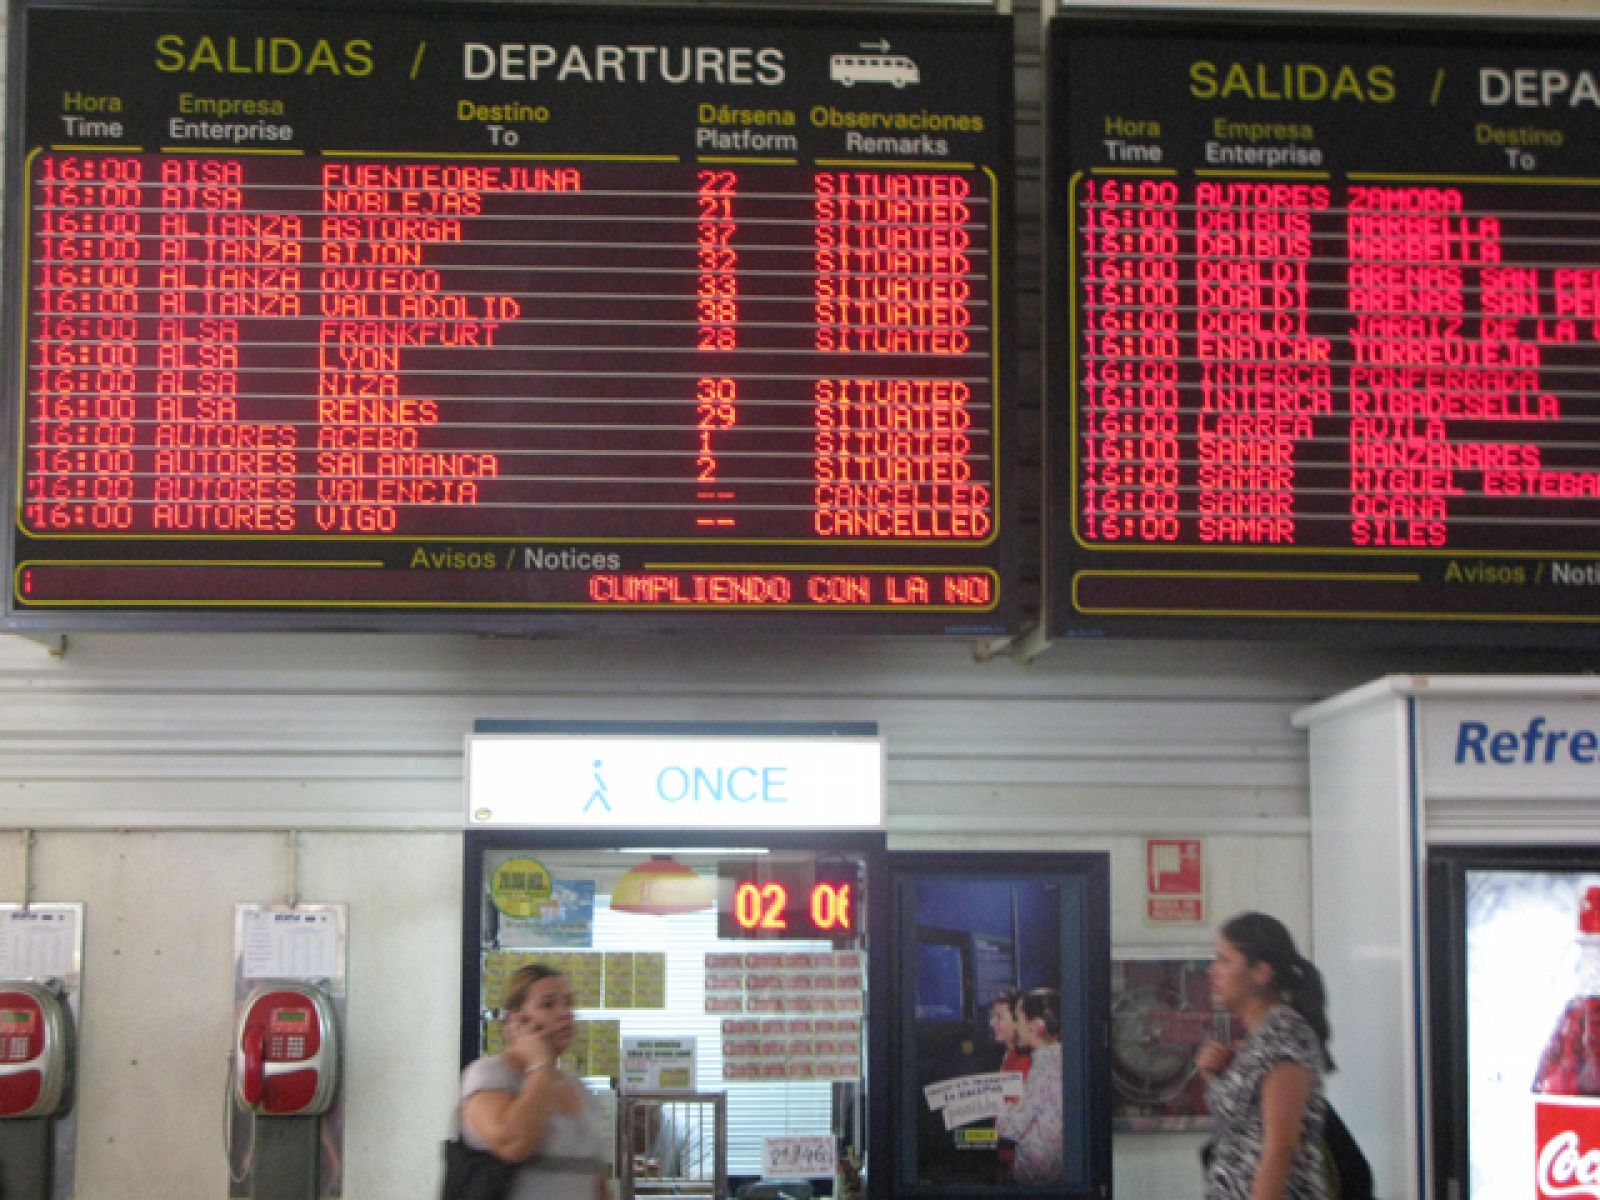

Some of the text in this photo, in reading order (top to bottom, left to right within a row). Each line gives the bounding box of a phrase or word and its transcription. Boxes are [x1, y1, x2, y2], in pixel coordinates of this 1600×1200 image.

[156, 33, 374, 76] SALIDAS
[464, 42, 786, 85] DEPARTURES
[1190, 61, 1396, 103] SALIDAS
[64, 92, 122, 112] Hora
[180, 93, 284, 116] Empresa
[458, 100, 551, 124] Destino
[700, 104, 797, 127] Dársena
[62, 117, 122, 138] Time
[170, 119, 292, 142] Enterprise
[812, 106, 985, 132] Observaciones
[1106, 117, 1161, 138] Hora
[1214, 118, 1313, 141] Empresa
[486, 125, 519, 146] To
[697, 128, 798, 151] Platform
[846, 132, 948, 155] Remarks
[1477, 124, 1564, 145] Destino
[1105, 140, 1163, 161] Time
[1206, 143, 1323, 166] Enterprise
[1505, 149, 1536, 169] To
[44, 160, 970, 199] 16:00 AISA FUENTEOBEJUNA 22 SITUATED
[44, 187, 971, 224] 16:00 AISA NOBLEJAS 21 SITUATED
[1086, 180, 1463, 211] 16:00 AUTORES ZAMORA
[43, 213, 970, 250] 16:00 ALIANZA ASTORGA 37 SITUATED
[1086, 206, 1500, 237] 16:00 DAIBUS MARBELLA
[43, 240, 971, 276] 16:00 ALIANZA GIJON 32 SITUATED
[1085, 232, 1501, 263] 16:00 DAIBUS MARBELLA
[41, 266, 971, 302] 16:00 ALIANZA OVIEDO 33 SITUATED
[1086, 258, 1179, 282] 16:00
[1348, 263, 1464, 288] ARENAS
[1480, 266, 1539, 289] SAN
[41, 293, 971, 327] 16:00 ALIANZA VALLADOLID 38 SITUATED
[1086, 284, 1179, 308] 16:00
[1348, 289, 1464, 313] ARENAS
[1481, 291, 1540, 315] SAN
[40, 319, 970, 353] 16:00 ALSA FRANKFURT 28 SITUATED
[1086, 310, 1179, 333] 16:00
[1350, 315, 1463, 339] JARAIZ
[1481, 317, 1518, 340] DE
[1536, 318, 1577, 341] LA
[39, 346, 401, 372] 16:00 ALSA LYON
[1086, 336, 1540, 365] 16:00 ENATCAR TORREVIEJA
[38, 372, 971, 405] 16:00 ALSA NIZA 30 SITUATED
[1085, 361, 1539, 391] 16:00 INTERCA PONFERRADA
[38, 399, 971, 430] 16:00 ALSA RENNES 29 SITUATED
[1087, 387, 1559, 417] 16:00 INTERCA RIBADESELLA
[37, 425, 971, 456] 16:00 AUTORES ACEBO 1 SITUATED
[1087, 413, 1446, 442] 16:00 LARREA AVILA
[37, 452, 972, 482] 16:00 AUTORES SALAMANCA 2 SITUATED
[1086, 439, 1540, 469] 16:00 SAMAR MANZANARES
[29, 478, 989, 508] 16:00 AUTORES VALENCIA CANCELLED
[1085, 465, 1600, 495] 16:00 SAMAR MIGUEL ESTEBA
[1084, 491, 1179, 514] 16:00
[1199, 492, 1294, 515] SAMAR
[27, 504, 990, 534] 16:00 AUTORES VIGO CANCELLED
[1086, 517, 1446, 544] 16:00 SAMAR SILES
[411, 547, 620, 570] Avisos Notices
[1445, 561, 1526, 583] Avisos
[588, 575, 792, 604] CUMPLIENDO
[806, 576, 871, 604] CON
[884, 575, 931, 604] LA
[657, 767, 787, 802] ONCE
[738, 883, 788, 930] 02
